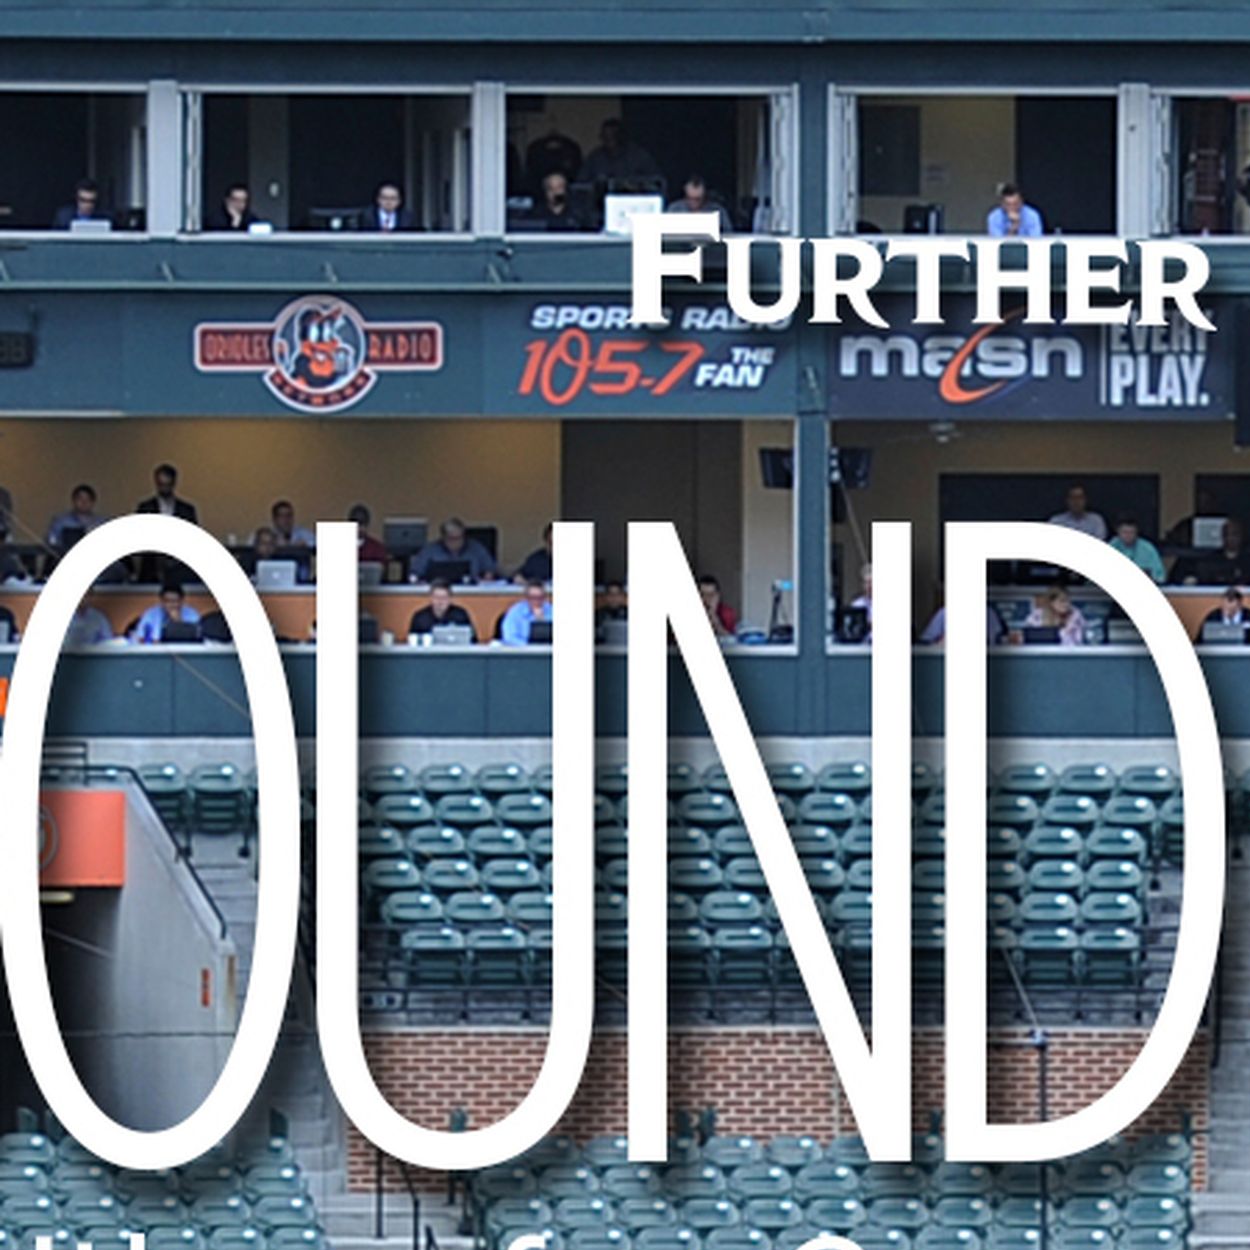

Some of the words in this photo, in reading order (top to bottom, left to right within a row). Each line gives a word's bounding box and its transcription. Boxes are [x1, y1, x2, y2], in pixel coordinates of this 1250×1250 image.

[204, 333, 270, 361] ORIOLES
[368, 333, 432, 361] RADIO
[731, 348, 774, 365] THE
[840, 336, 1083, 377] masn
[695, 365, 763, 387] FAN
[1110, 355, 1210, 405] PLAY.
